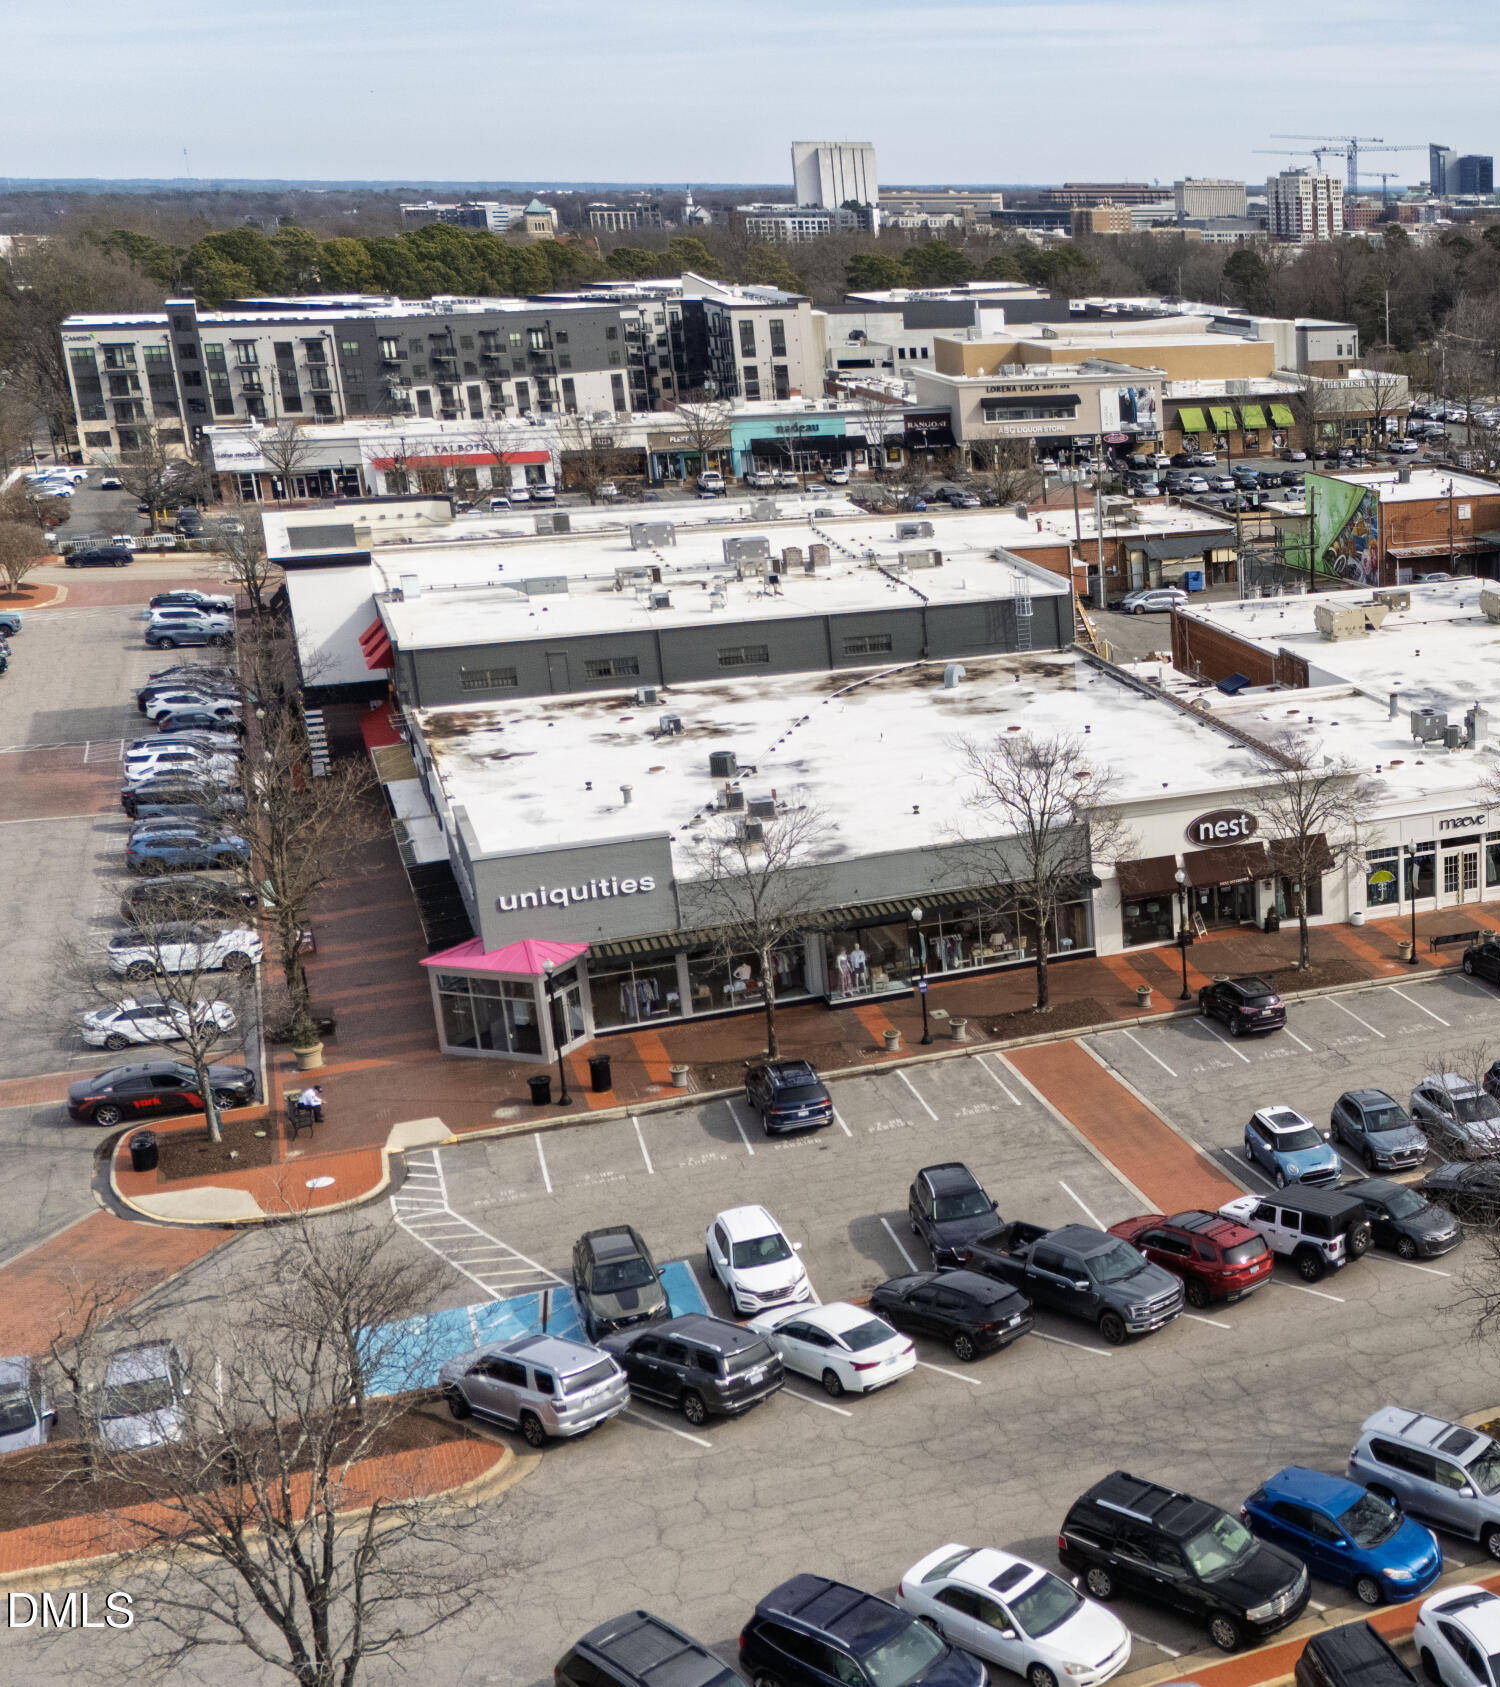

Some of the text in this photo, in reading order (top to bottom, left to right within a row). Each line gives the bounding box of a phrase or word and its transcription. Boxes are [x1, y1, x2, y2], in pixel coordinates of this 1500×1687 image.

[776, 423, 819, 433] nadeau
[1016, 426, 1041, 434] LIQUOR
[433, 443, 489, 454] TALBOTS
[1199, 814, 1250, 840] nest
[1439, 813, 1487, 832] maeve
[498, 873, 656, 911] uniquities
[132, 1097, 161, 1109] york
